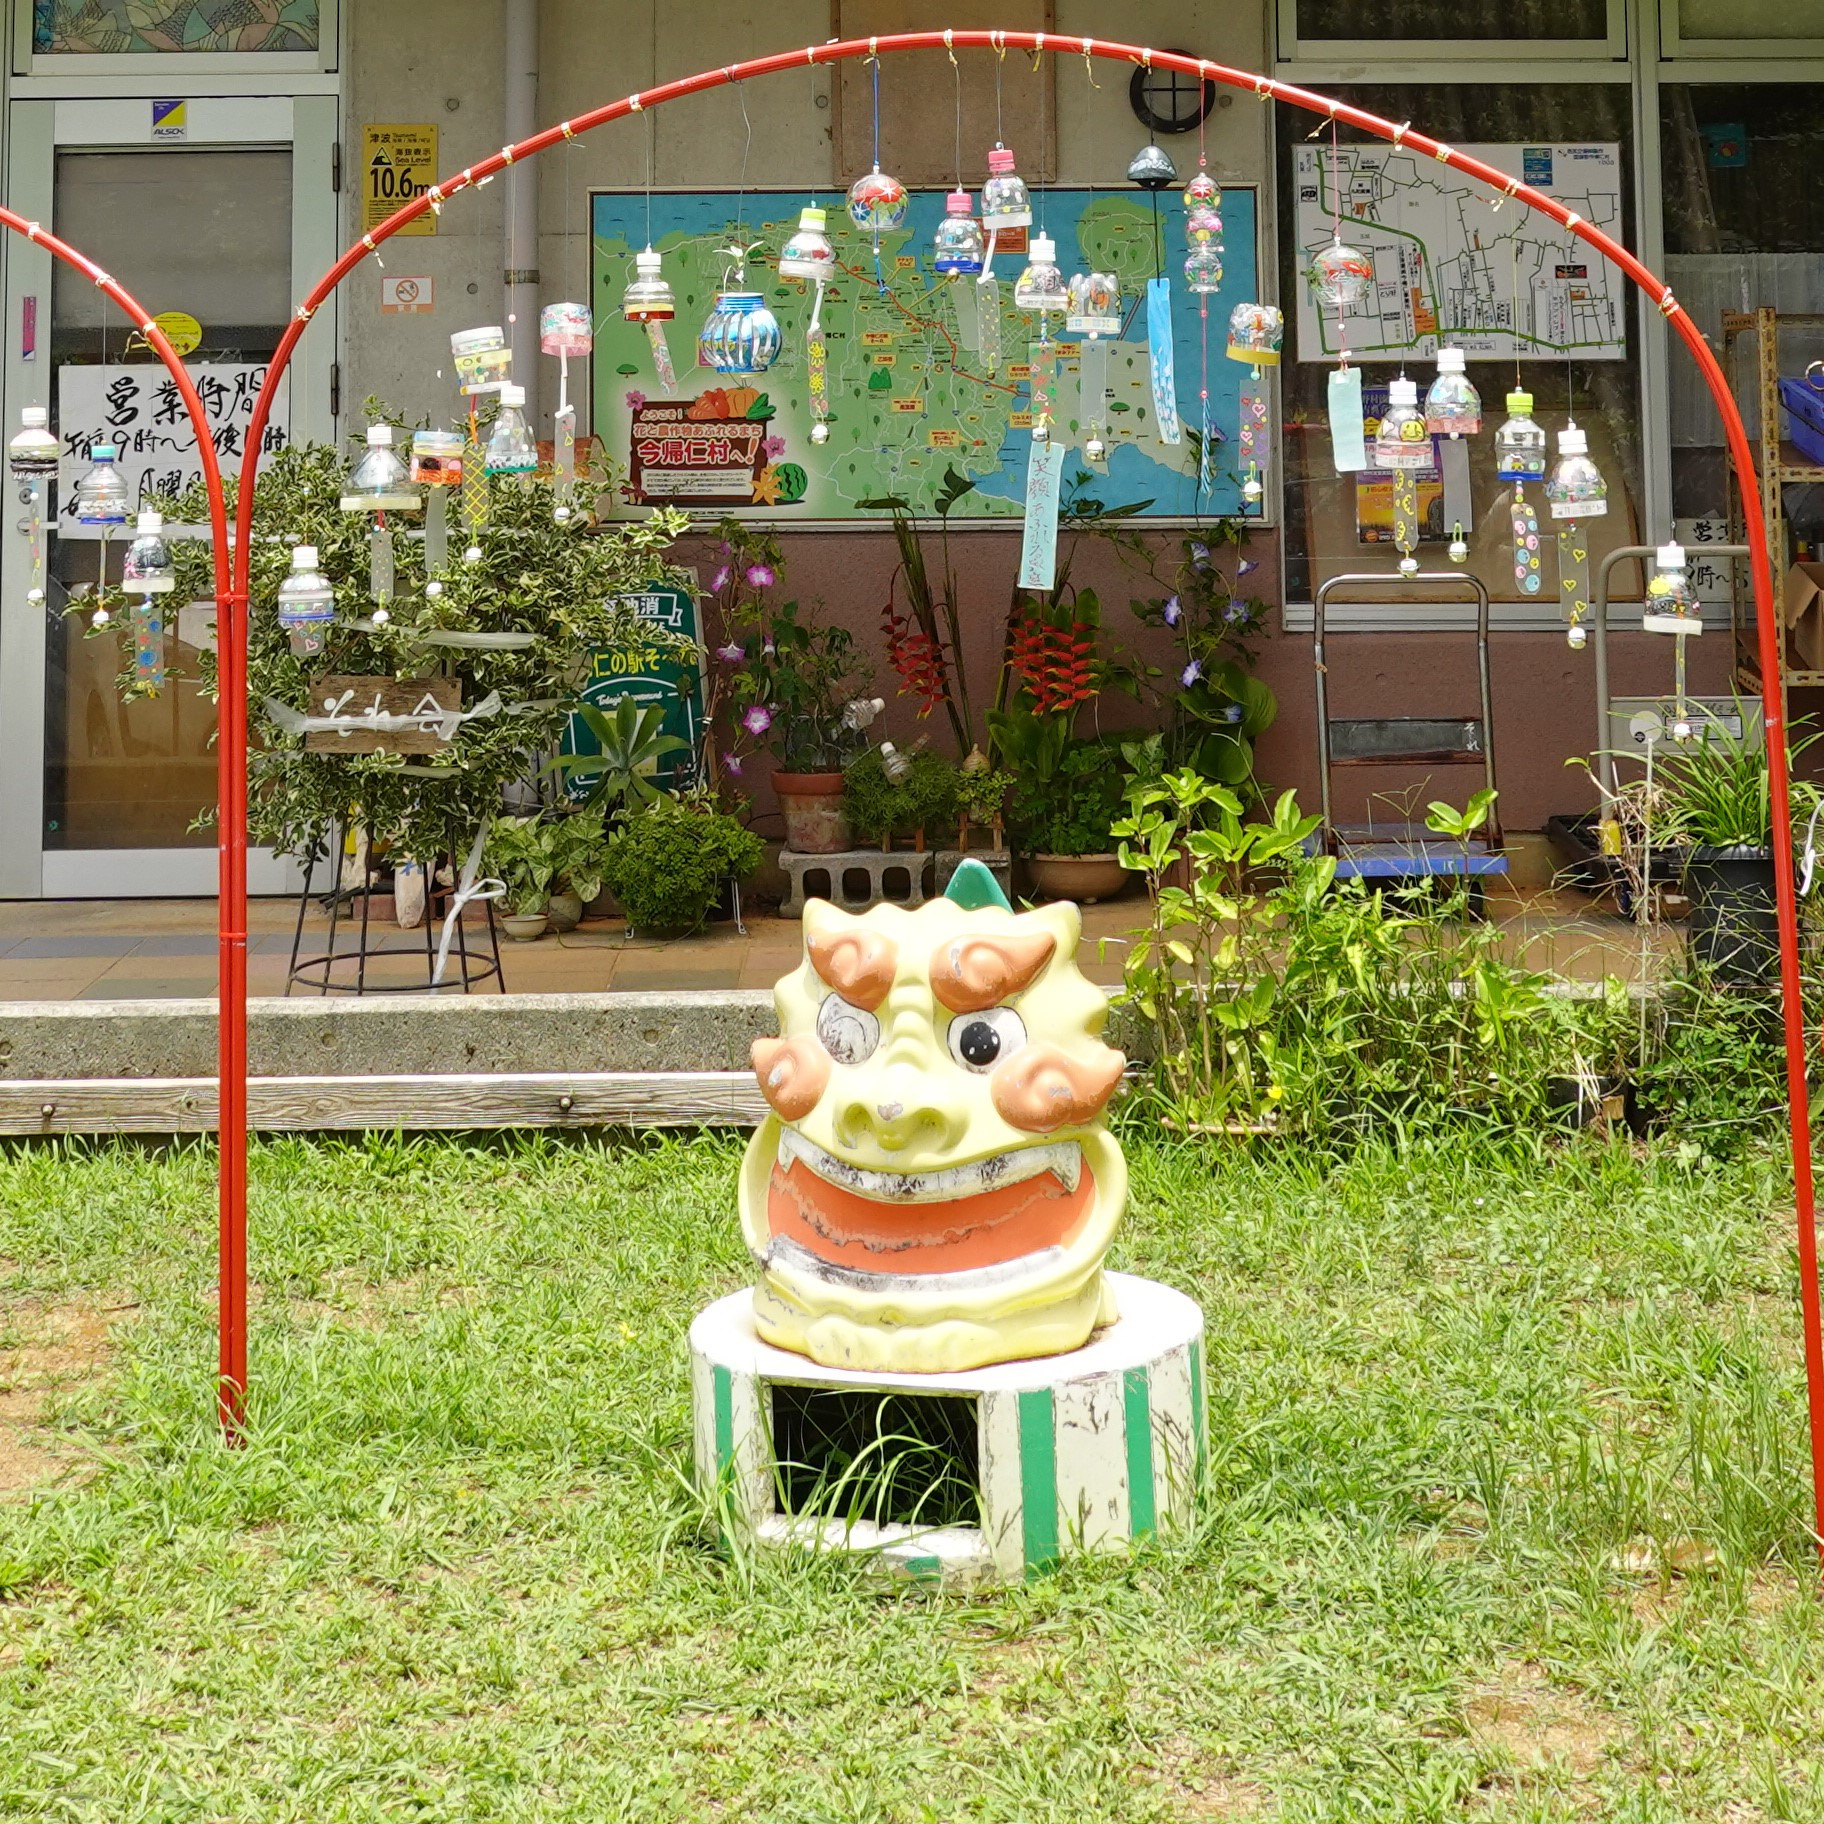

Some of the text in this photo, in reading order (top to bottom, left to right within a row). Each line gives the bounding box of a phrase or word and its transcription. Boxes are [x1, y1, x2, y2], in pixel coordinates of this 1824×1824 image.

[633, 423, 764, 439] 花と農作物あふれるまち
